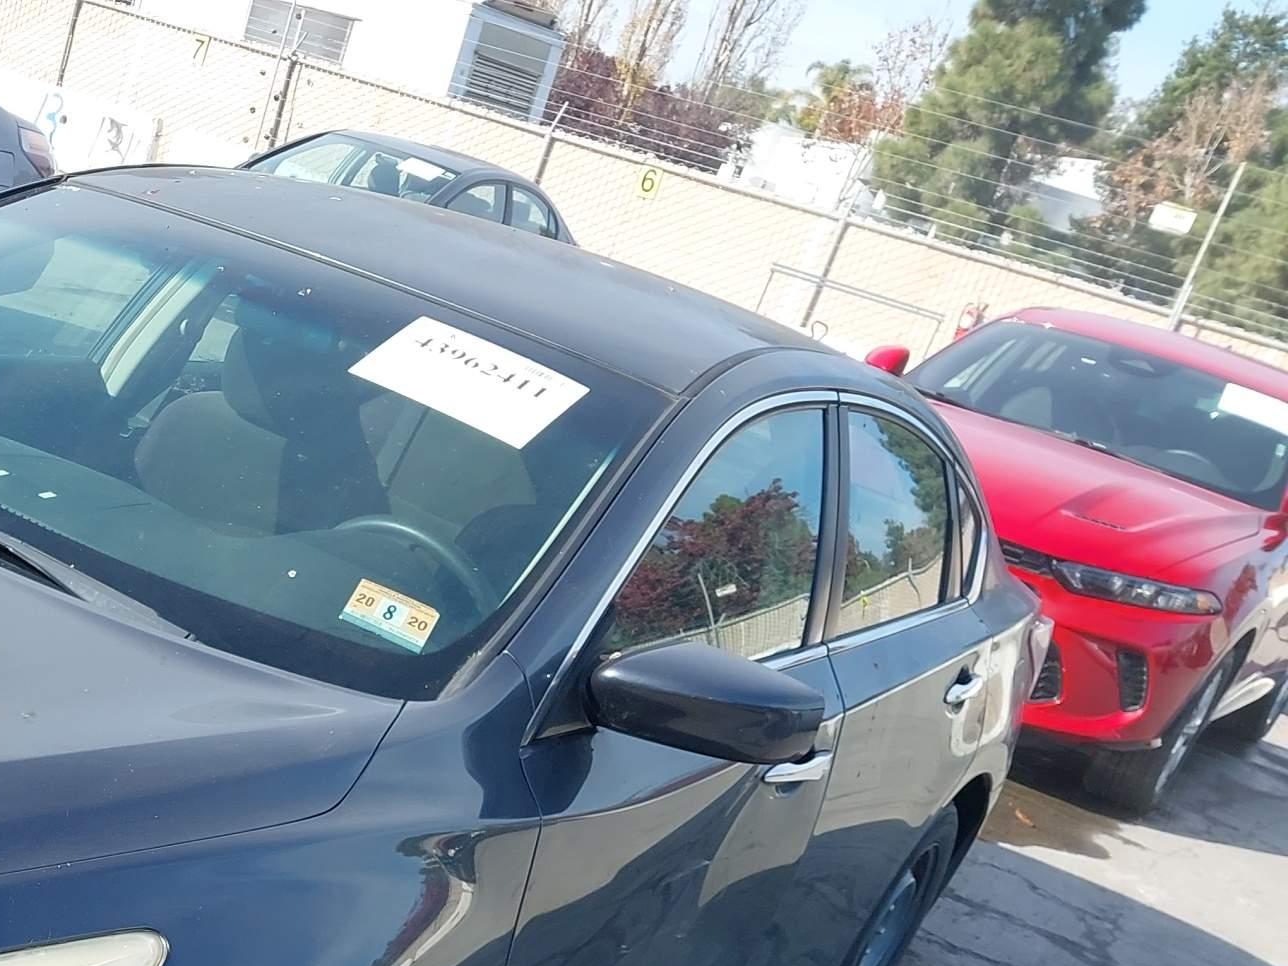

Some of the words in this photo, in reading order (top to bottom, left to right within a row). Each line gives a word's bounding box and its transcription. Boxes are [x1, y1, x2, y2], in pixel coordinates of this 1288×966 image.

[192, 38, 206, 60] 7
[640, 168, 657, 193] 6
[415, 337, 548, 399] 43962411
[355, 592, 376, 608] 20
[382, 604, 398, 621] 8
[407, 616, 429, 632] 20
